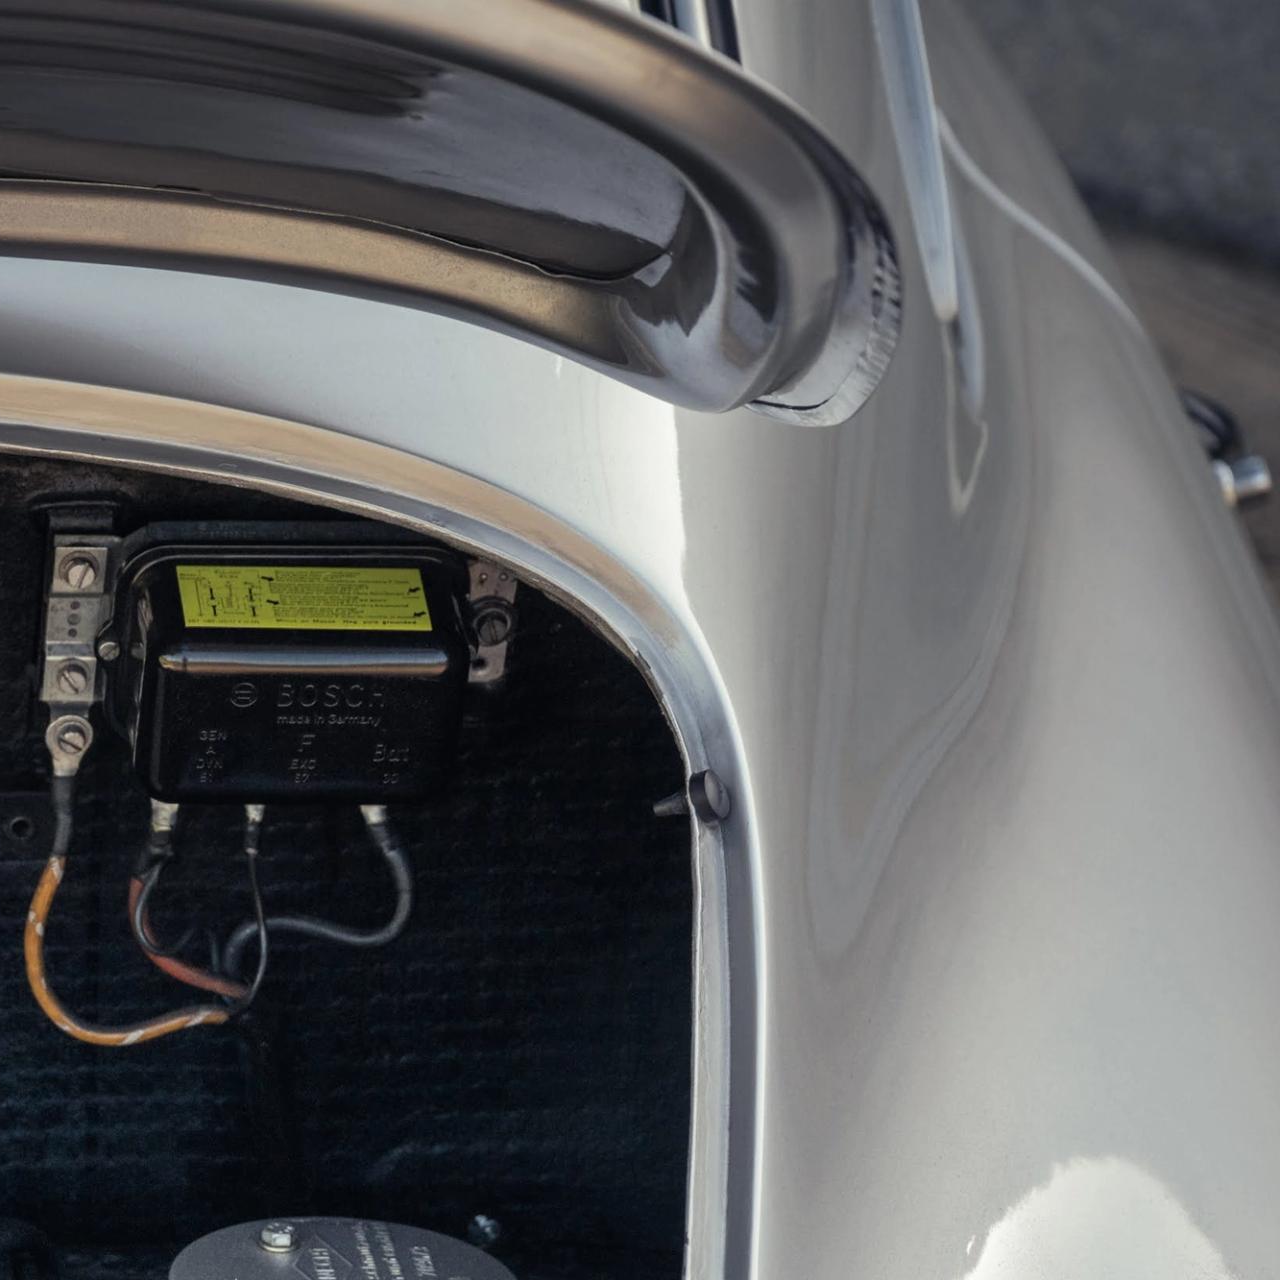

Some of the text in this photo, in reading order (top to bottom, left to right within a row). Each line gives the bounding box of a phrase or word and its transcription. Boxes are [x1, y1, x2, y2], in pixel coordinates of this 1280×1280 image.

[276, 683, 385, 708] BOSCH
[314, 713, 326, 725] in
[327, 713, 382, 727] Germany
